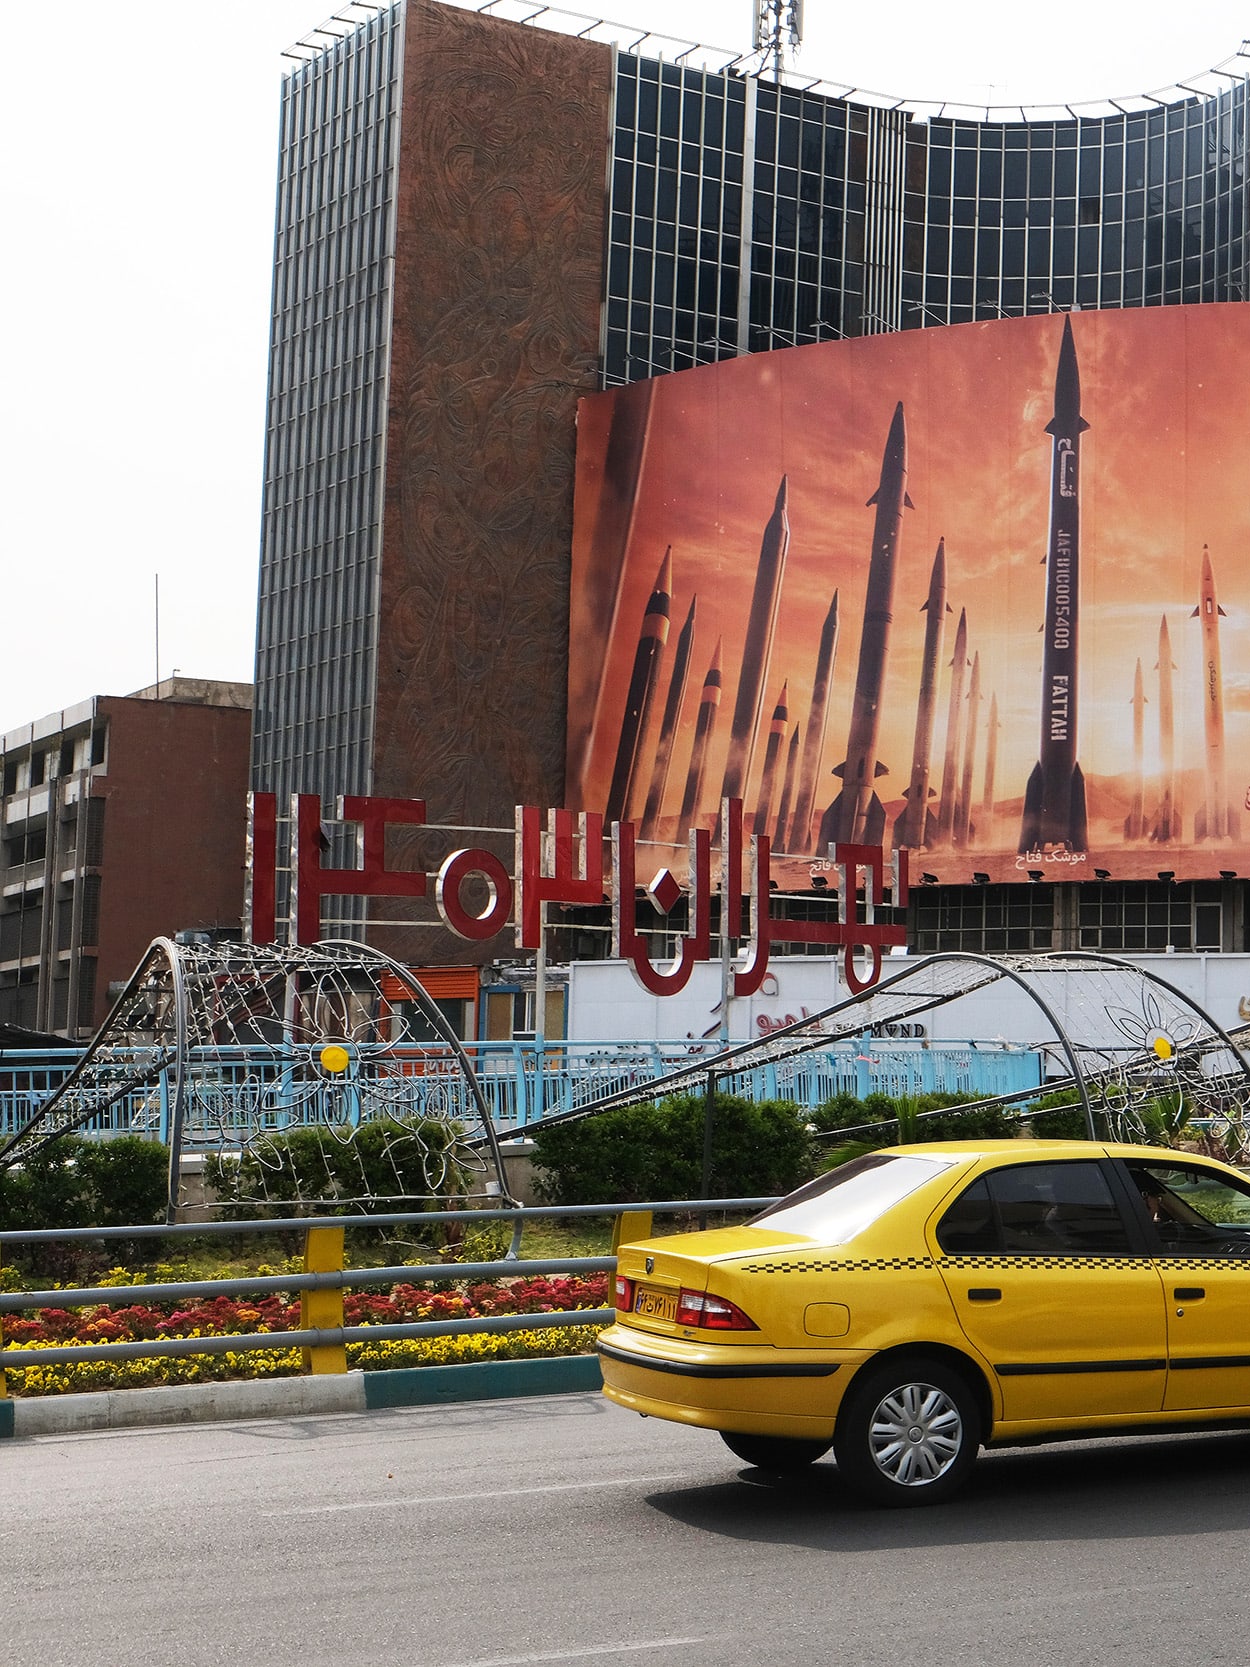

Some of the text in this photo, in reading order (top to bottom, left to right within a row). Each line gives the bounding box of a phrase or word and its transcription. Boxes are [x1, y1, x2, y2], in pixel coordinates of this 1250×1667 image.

[1050, 674, 1069, 742] FATTAH
[1015, 849, 1087, 870] موشک فتاح
